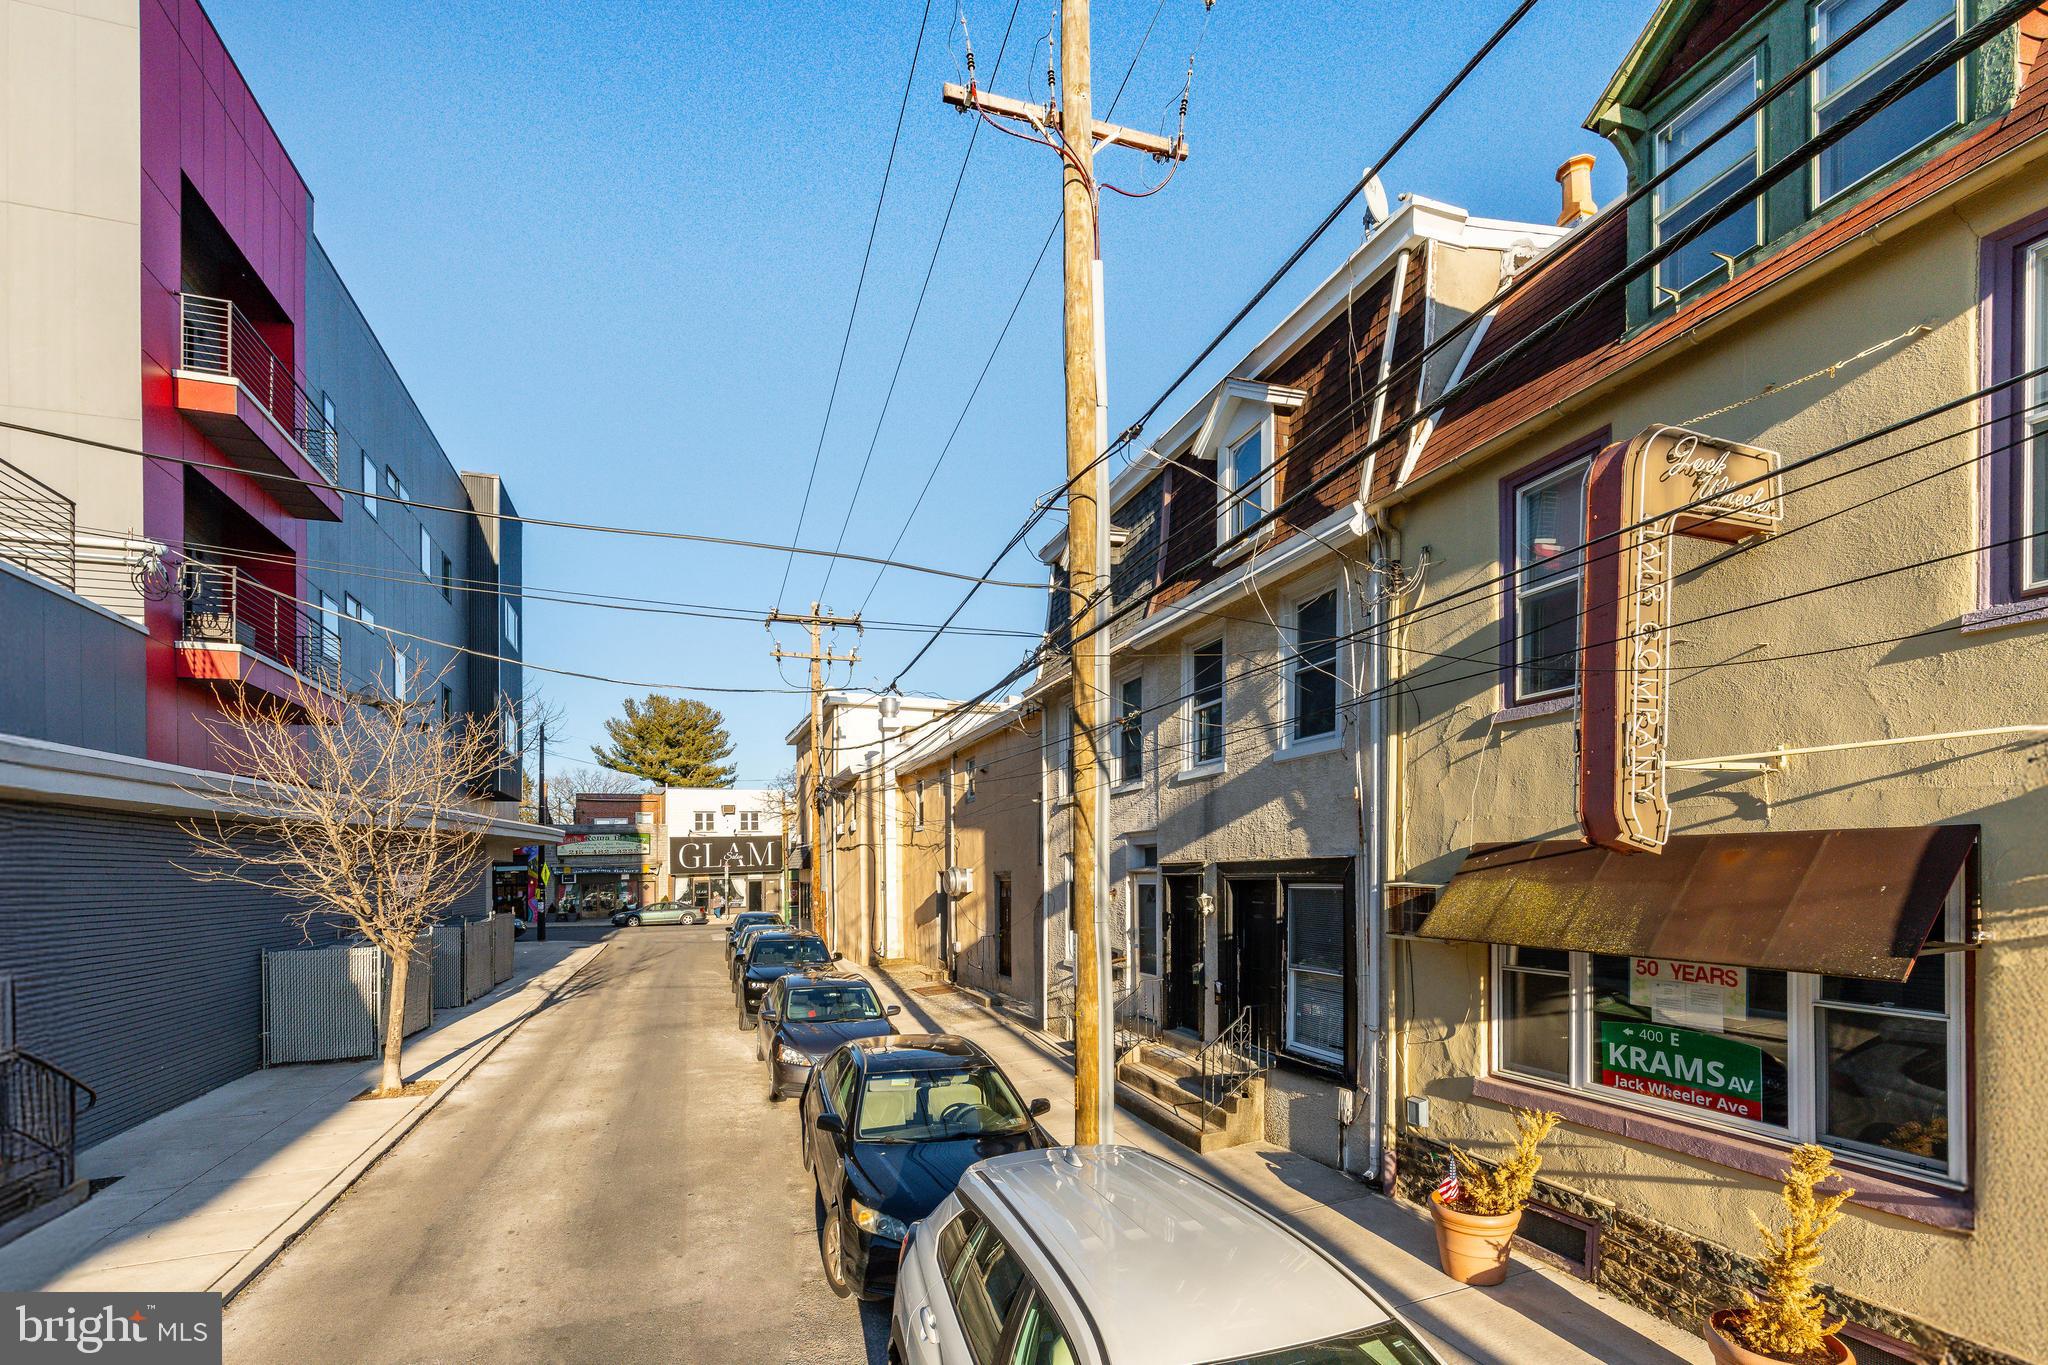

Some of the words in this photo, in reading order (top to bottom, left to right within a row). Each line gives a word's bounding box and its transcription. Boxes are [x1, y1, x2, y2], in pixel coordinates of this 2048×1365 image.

[1668, 435, 1731, 476] Jack
[678, 841, 775, 869] GLAM
[1635, 959, 1659, 978] 50
[1670, 962, 1739, 988] YEARS
[1639, 1028, 1663, 1043] 400
[1670, 1032, 1680, 1047] E
[1608, 1042, 1726, 1089] KRAMS
[1730, 1076, 1754, 1094] AV
[1614, 1074, 1645, 1091] Jack
[1647, 1081, 1712, 1107] Wheeler
[1717, 1098, 1749, 1116] Ave
